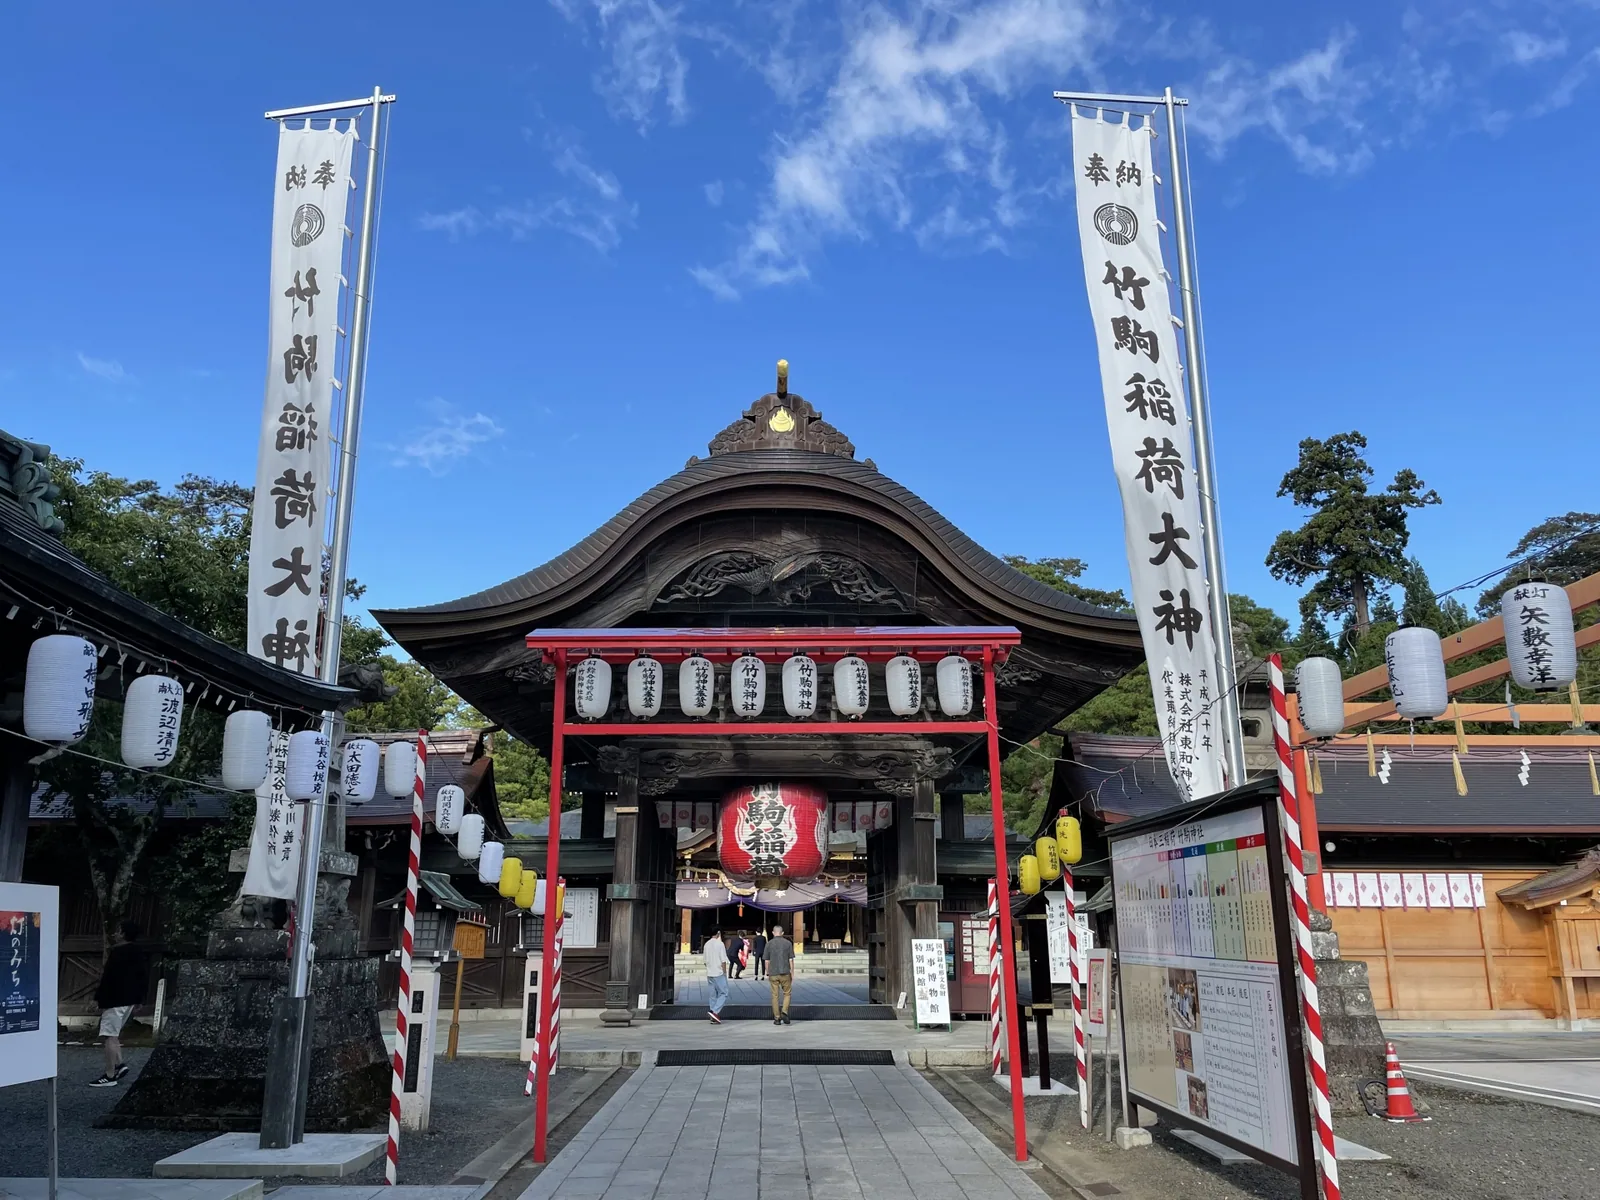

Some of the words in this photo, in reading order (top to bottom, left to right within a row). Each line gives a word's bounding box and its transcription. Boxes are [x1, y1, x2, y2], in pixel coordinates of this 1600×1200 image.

[1084, 152, 1141, 187] 奉納
[1102, 260, 1203, 652] 竹駒稲荷大神
[1513, 587, 1549, 601] 献灯
[158, 682, 183, 696] 献灯
[741, 664, 760, 711] 竹駒神社
[798, 664, 813, 710] 竹駒神社
[1198, 669, 1213, 753] 平成三十年
[344, 750, 362, 797] 太田徳之
[9, 915, 25, 988] 灯のみち
